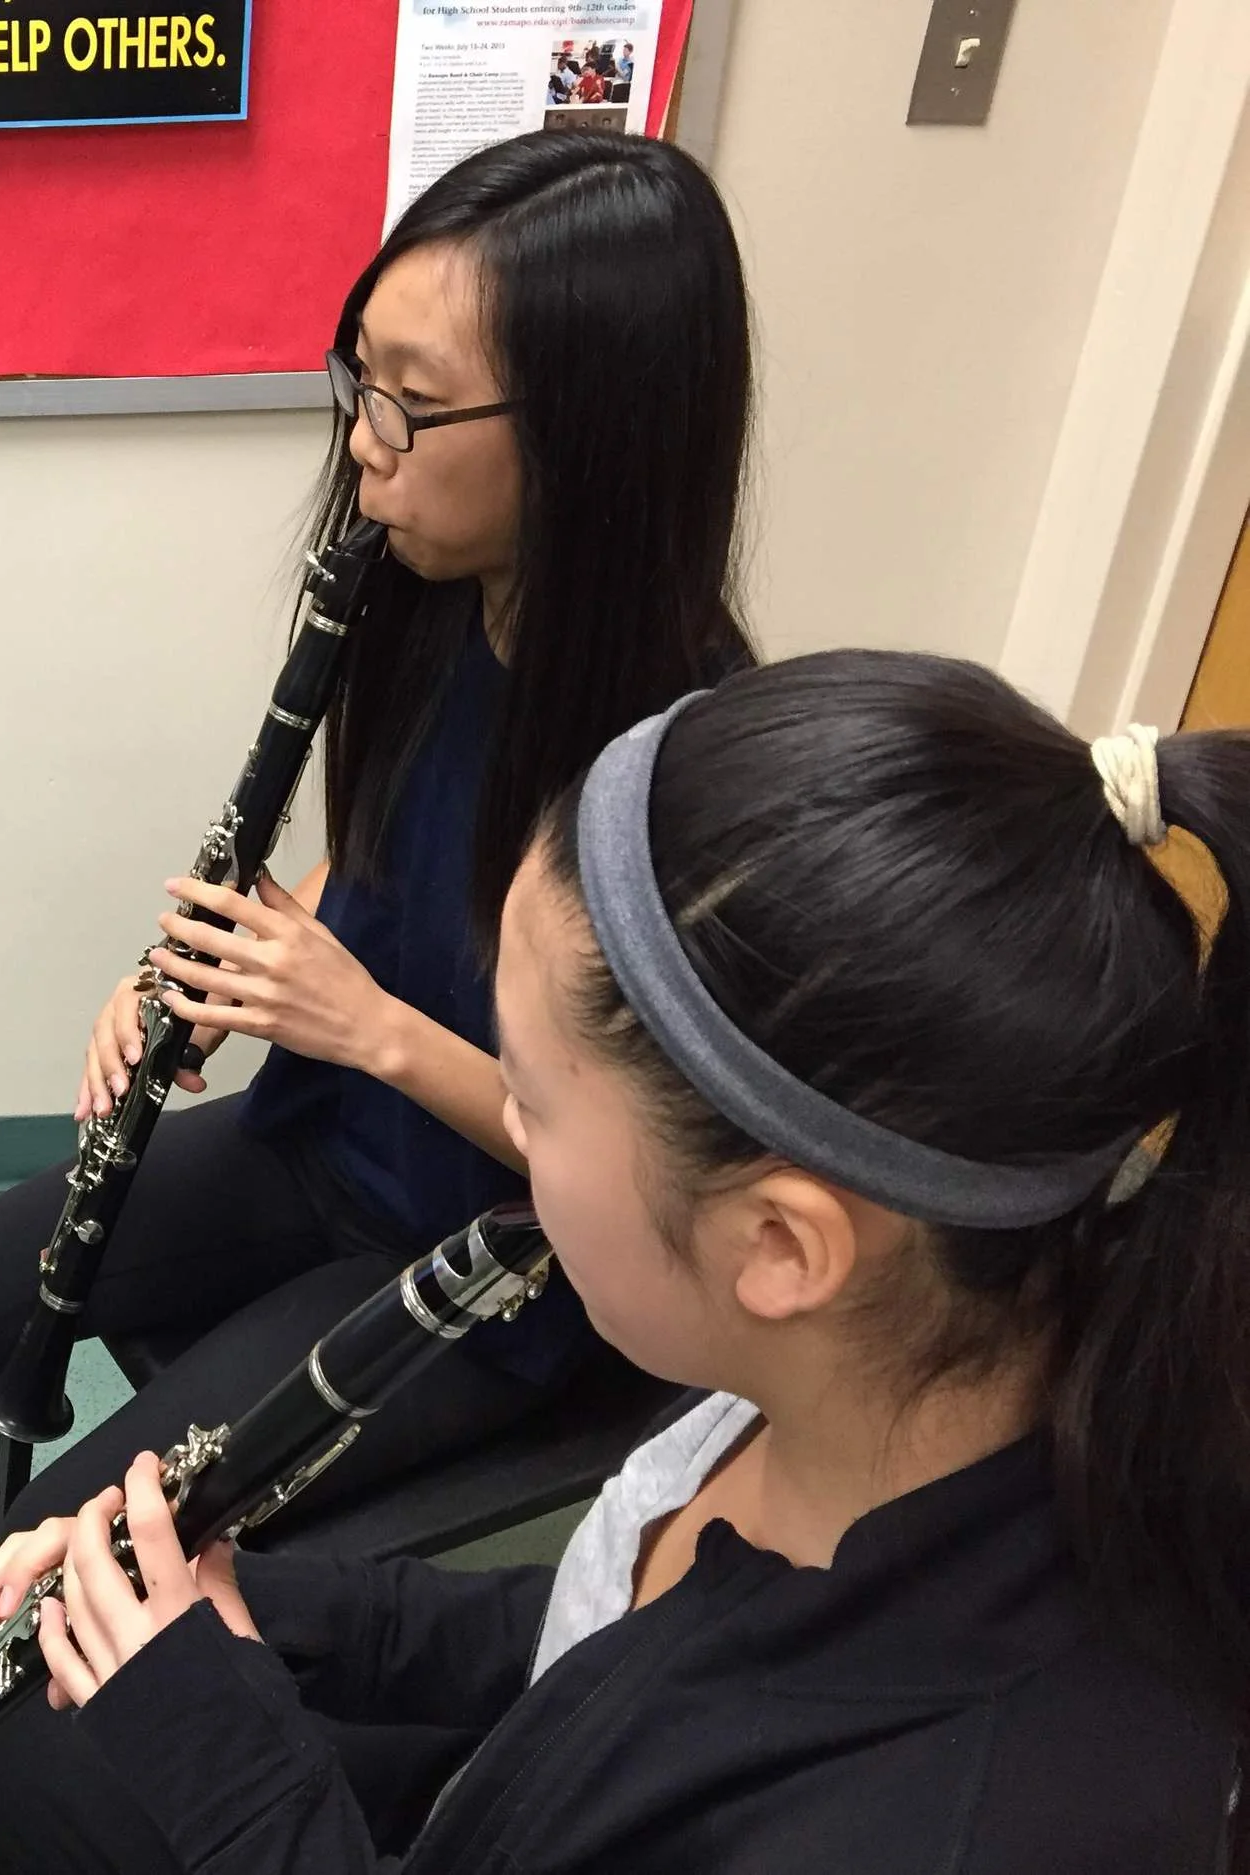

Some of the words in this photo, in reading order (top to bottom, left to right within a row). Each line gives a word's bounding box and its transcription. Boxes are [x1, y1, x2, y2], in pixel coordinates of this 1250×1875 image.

[422, 7, 436, 15] for
[438, 7, 458, 16] High
[460, 6, 489, 15] School
[492, 5, 528, 14] Students
[530, 5, 566, 15] entering
[607, 3, 636, 12] Grades
[63, 14, 226, 72] OTHERS.
